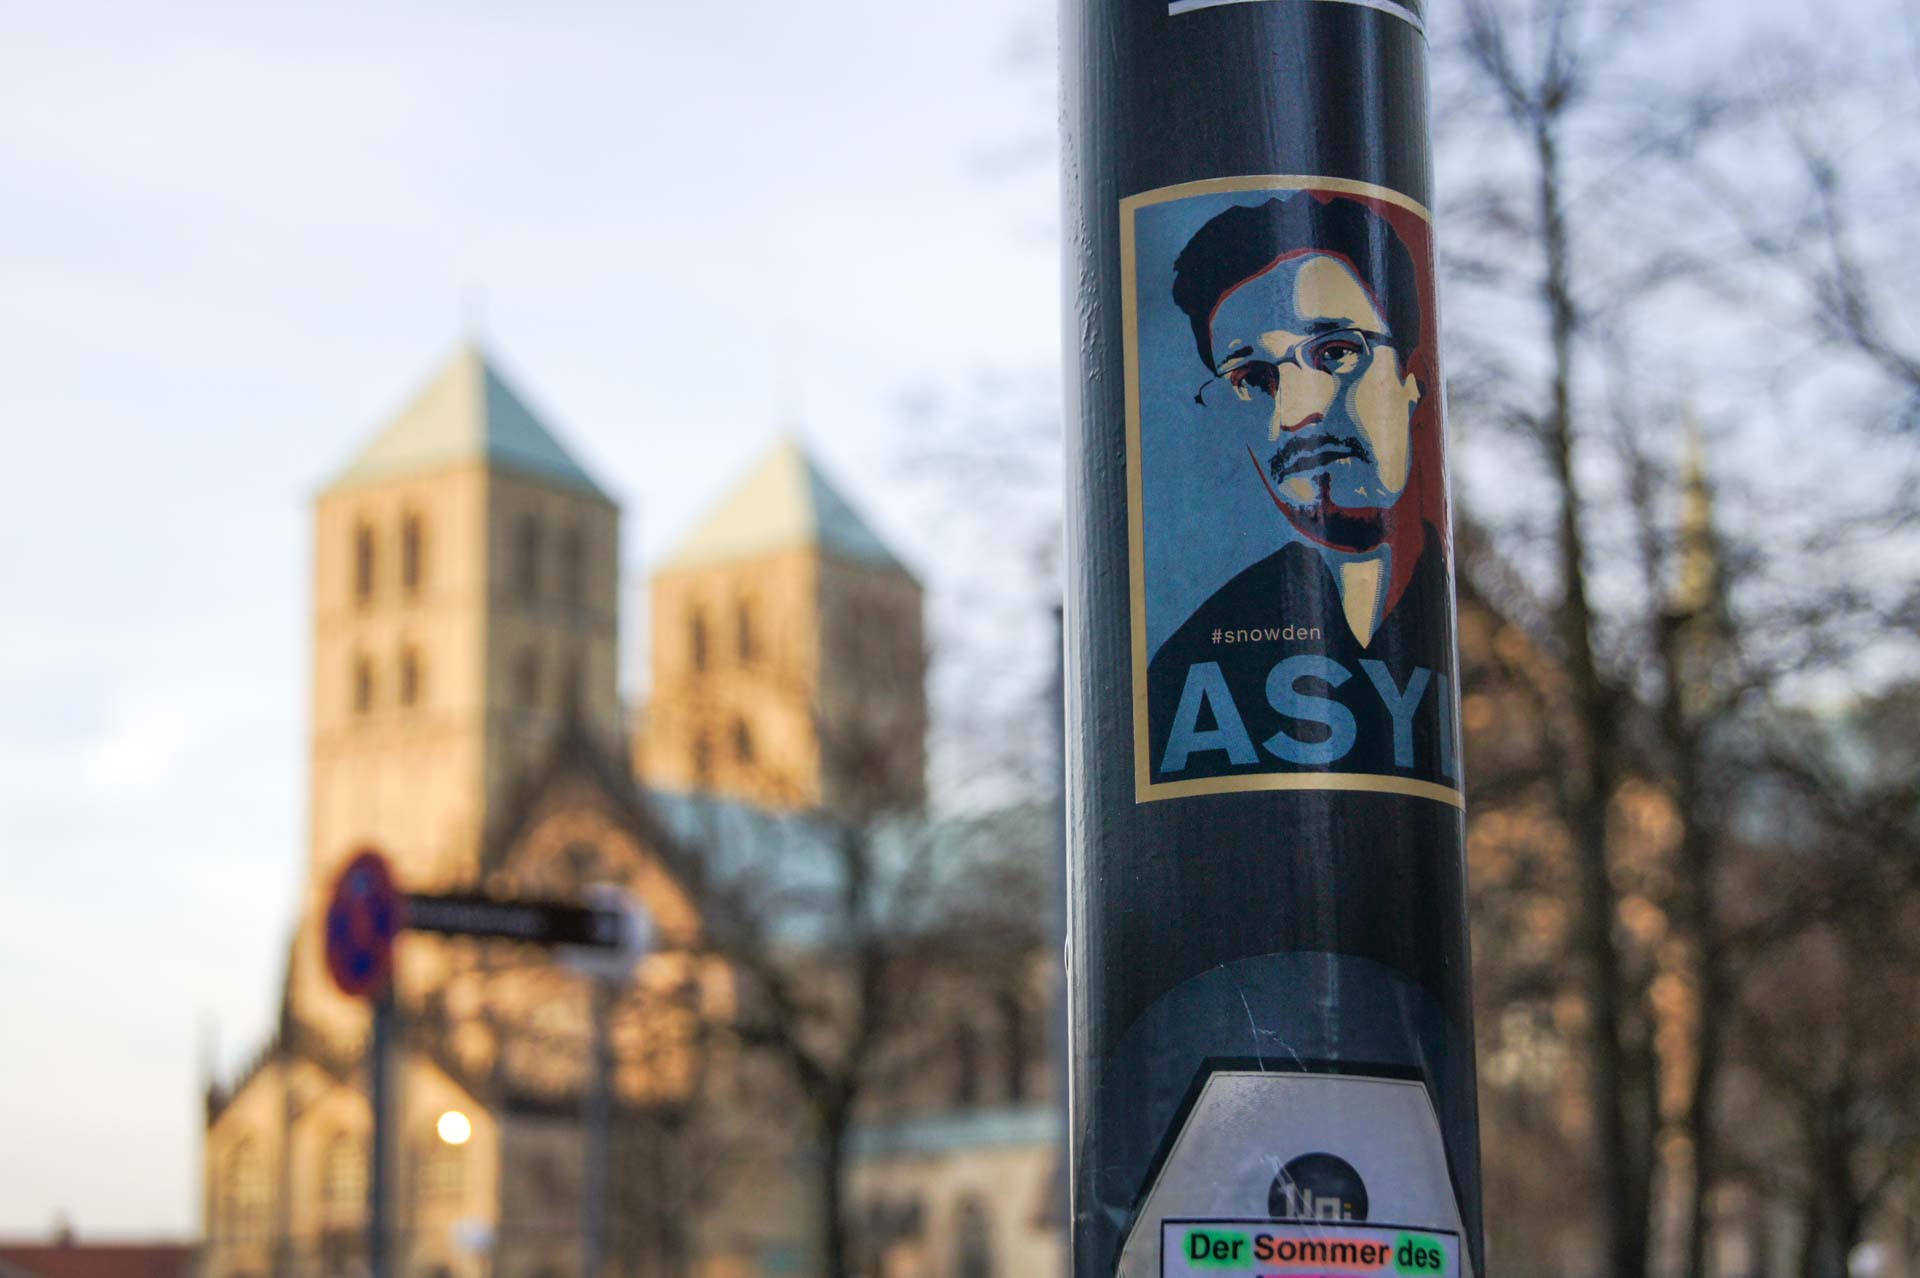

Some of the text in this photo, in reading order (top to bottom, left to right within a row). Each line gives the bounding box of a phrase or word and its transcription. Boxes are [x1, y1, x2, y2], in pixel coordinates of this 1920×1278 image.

[1211, 624, 1321, 645] #snowden
[1189, 1232, 1441, 1269] Der Sommer des
